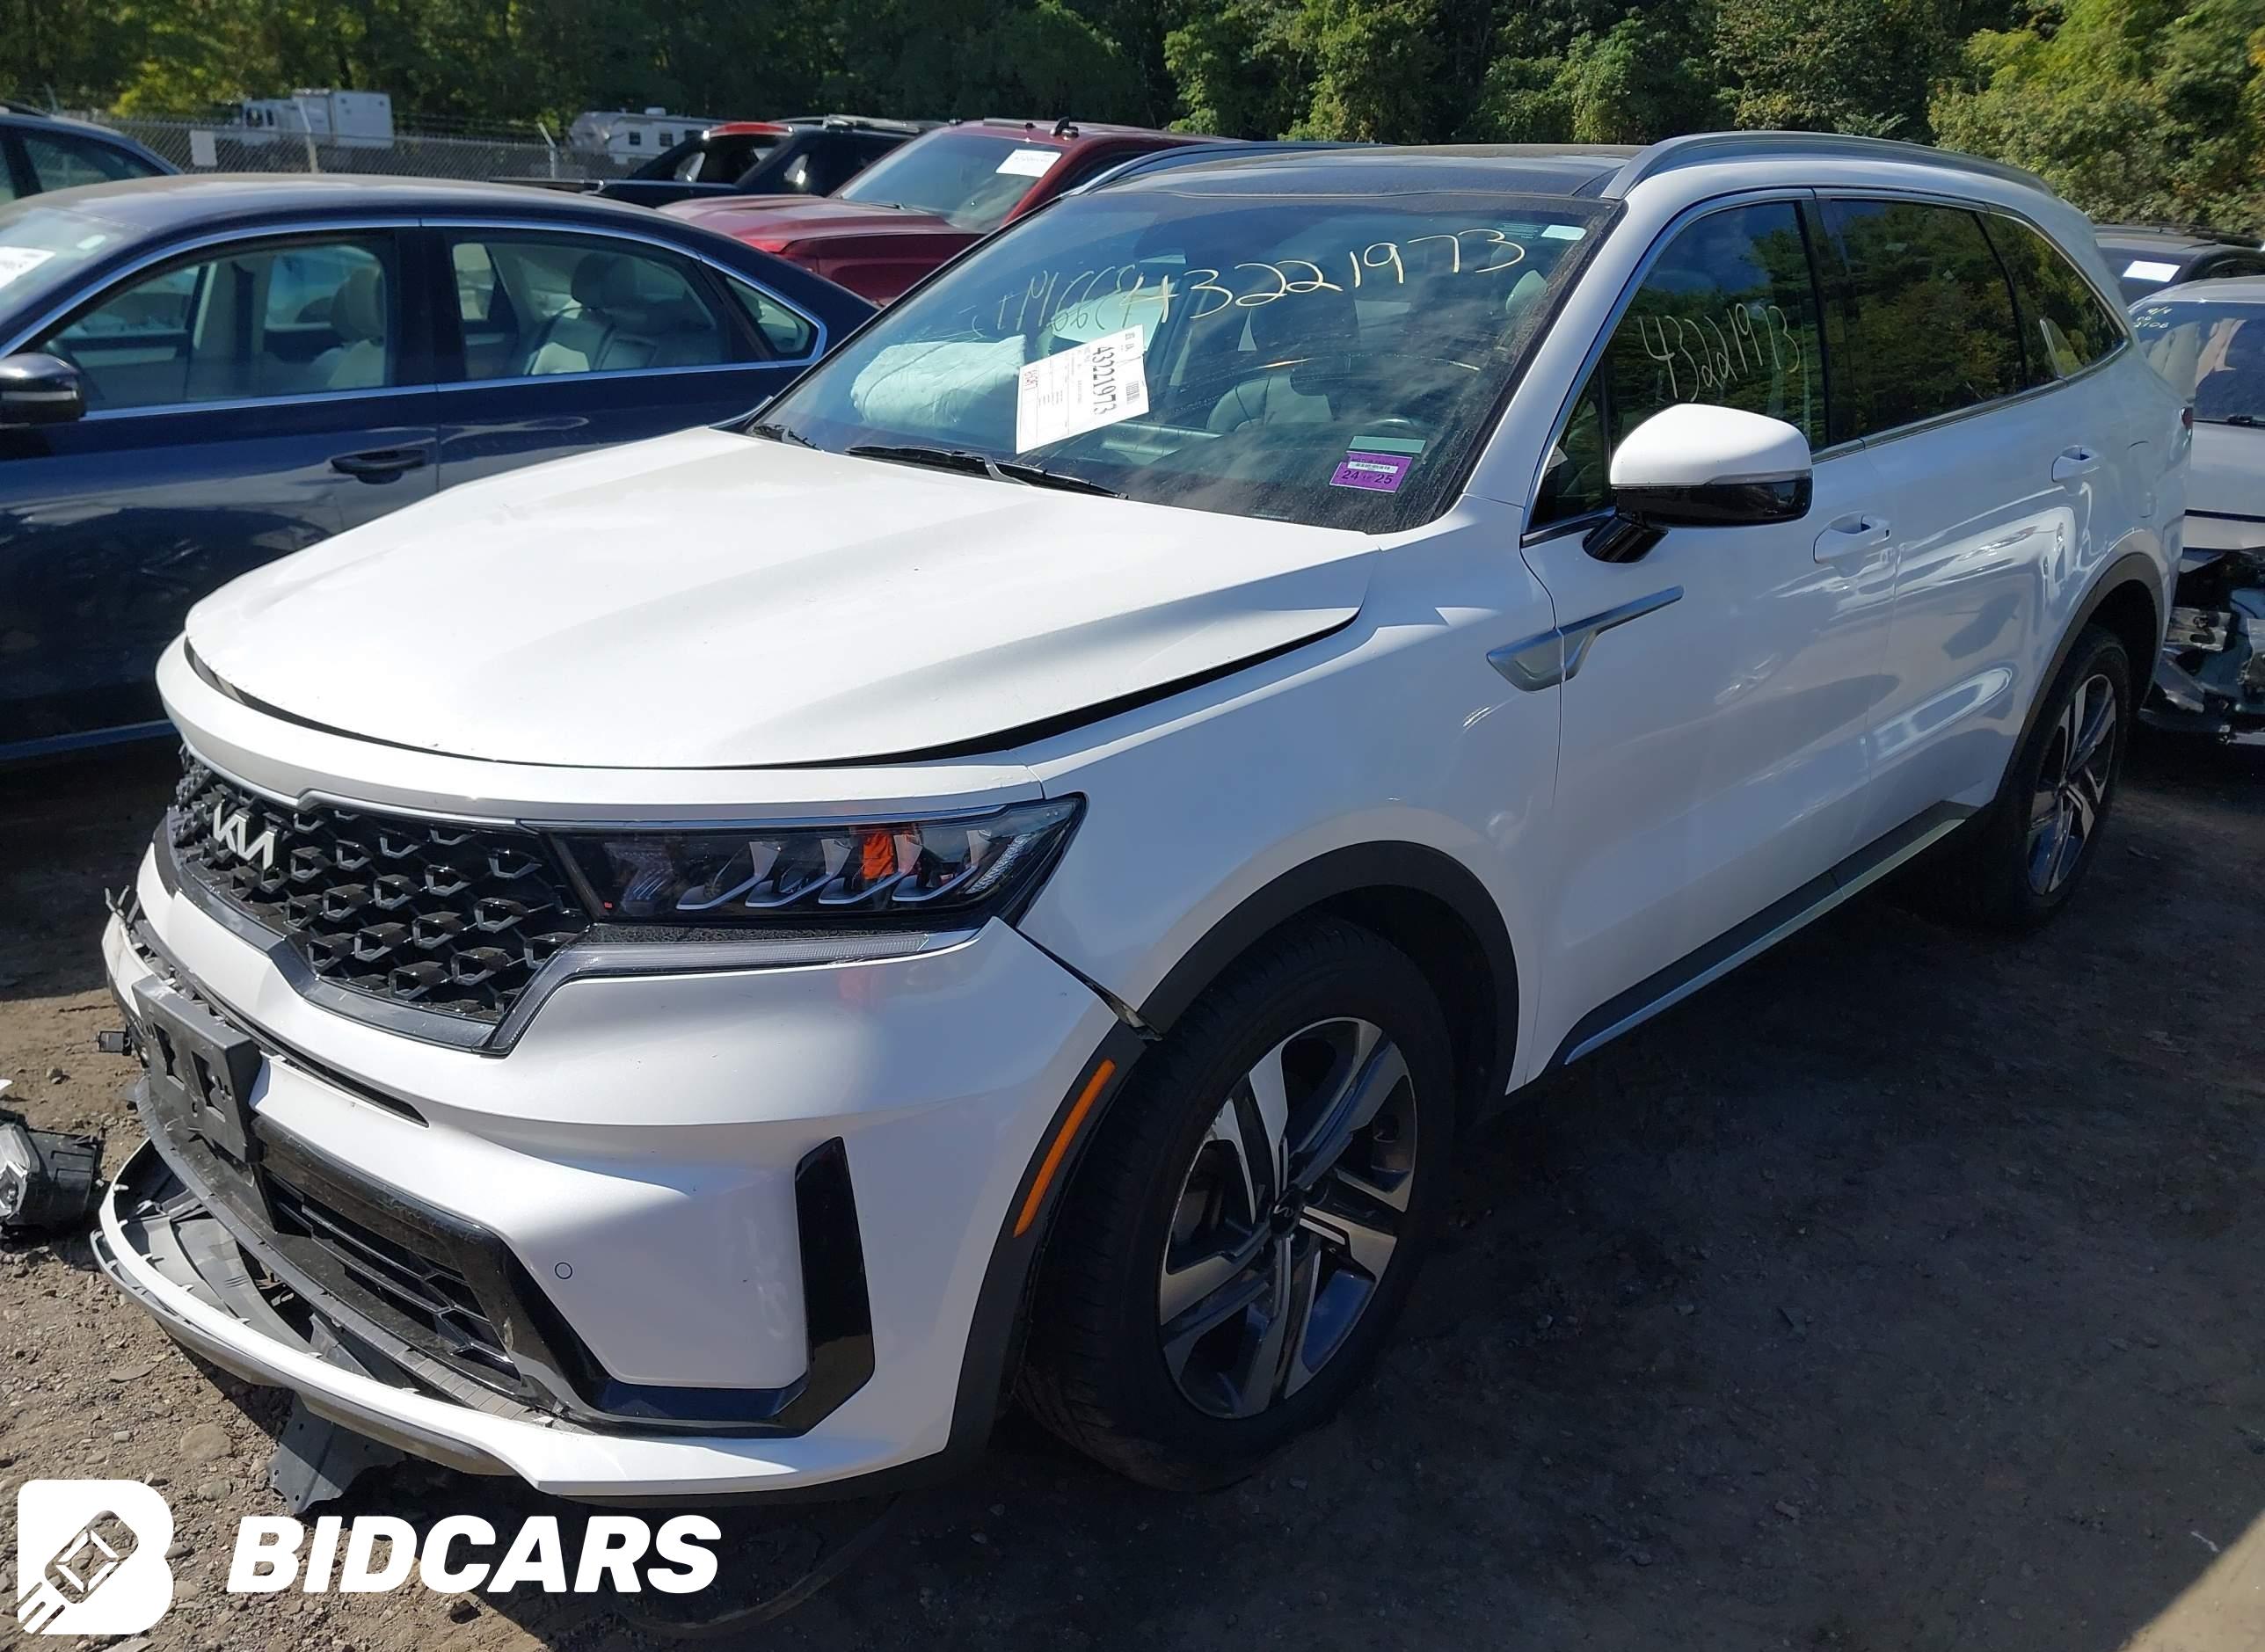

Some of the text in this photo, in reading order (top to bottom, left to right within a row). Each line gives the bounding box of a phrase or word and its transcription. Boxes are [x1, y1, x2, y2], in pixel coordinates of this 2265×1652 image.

[1119, 228, 1526, 324] 43221973
[1092, 346, 1117, 415] 43221973
[1636, 302, 1800, 402] 43221973
[1341, 469, 1359, 480] 24
[1374, 473, 1394, 484] 25
